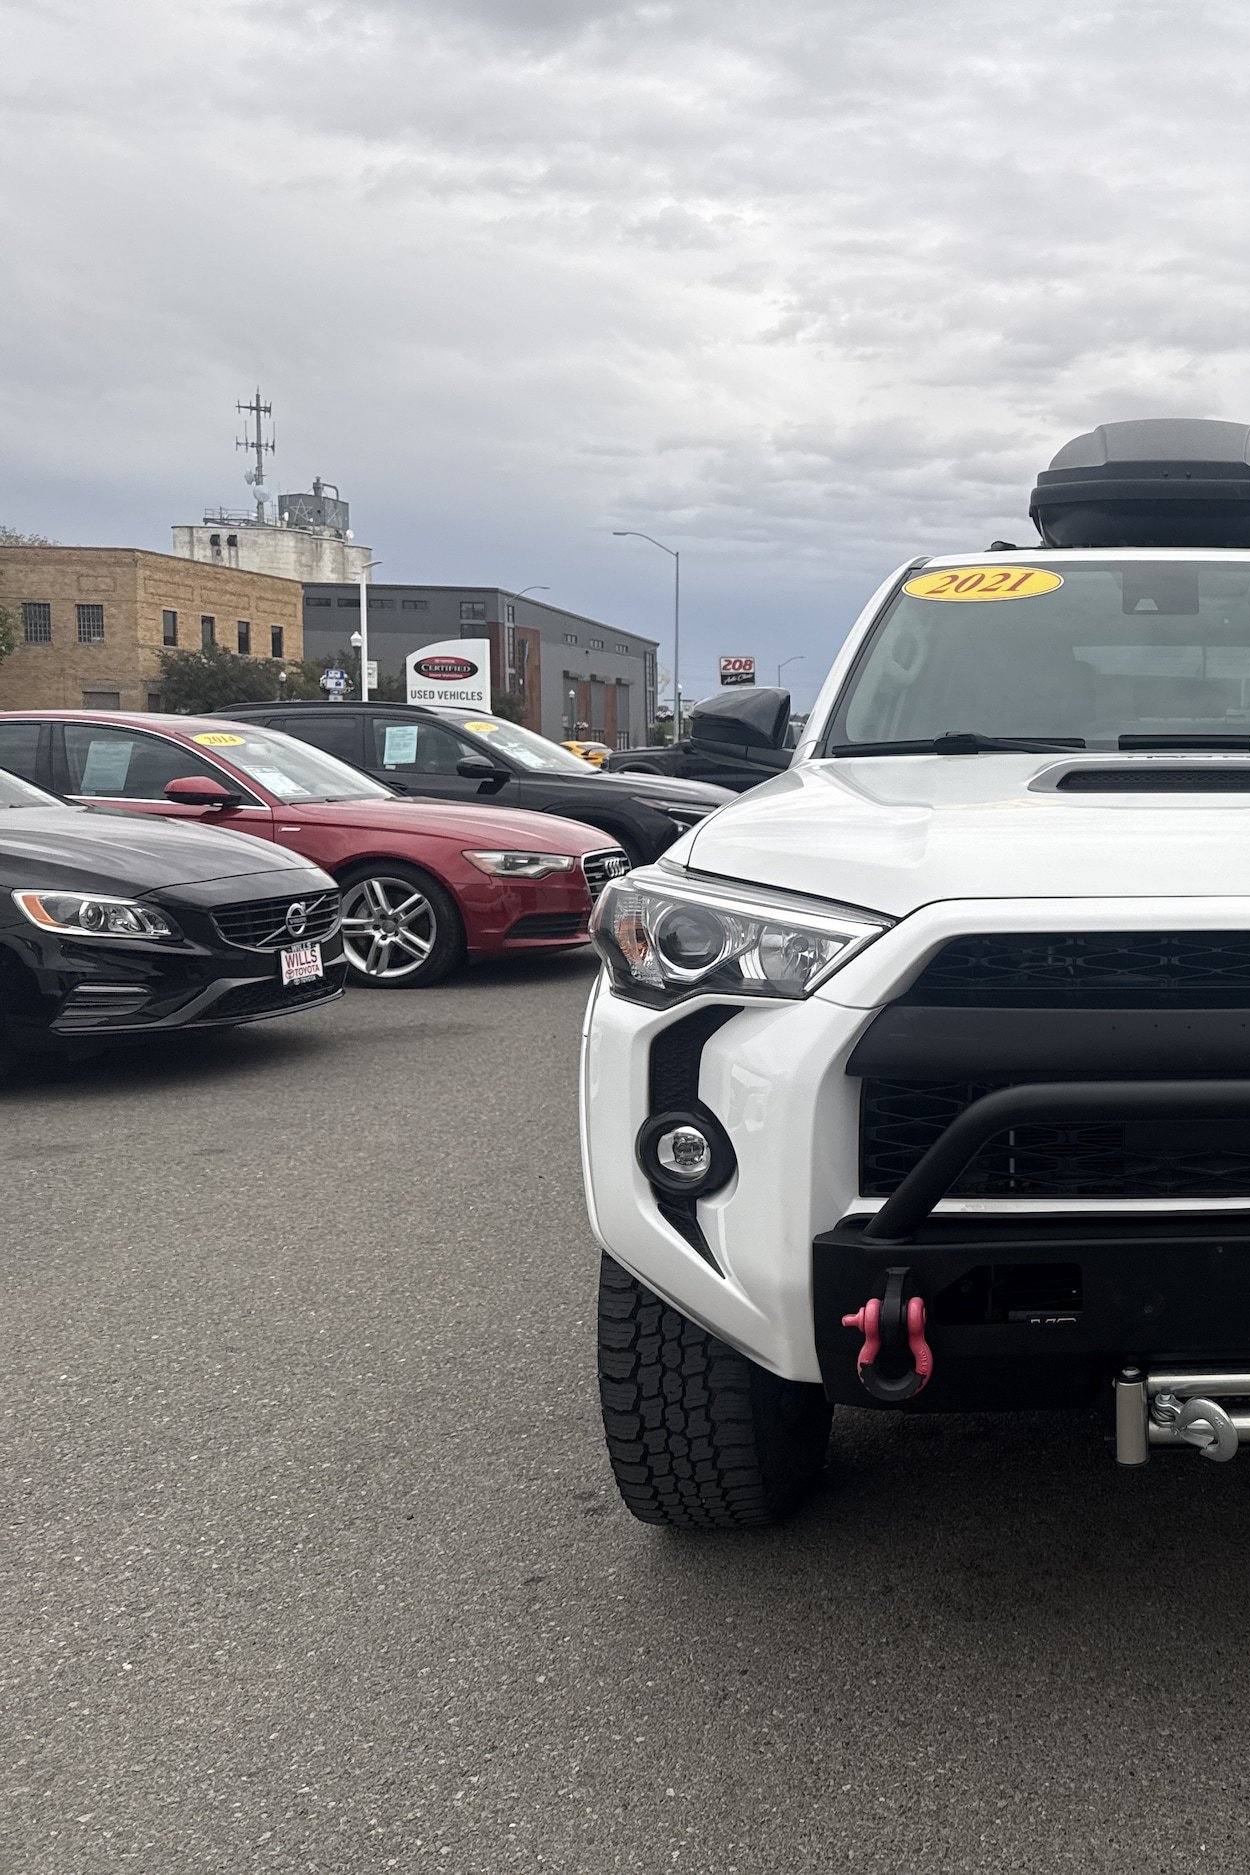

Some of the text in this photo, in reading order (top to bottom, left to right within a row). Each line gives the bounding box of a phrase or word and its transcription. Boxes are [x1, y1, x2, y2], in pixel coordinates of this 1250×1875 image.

[926, 572, 1035, 595] 2021
[723, 659, 753, 671] 208
[410, 689, 483, 701] USED VEHICLES
[285, 949, 318, 969] WILLS
[294, 964, 320, 977] TOYOTA
